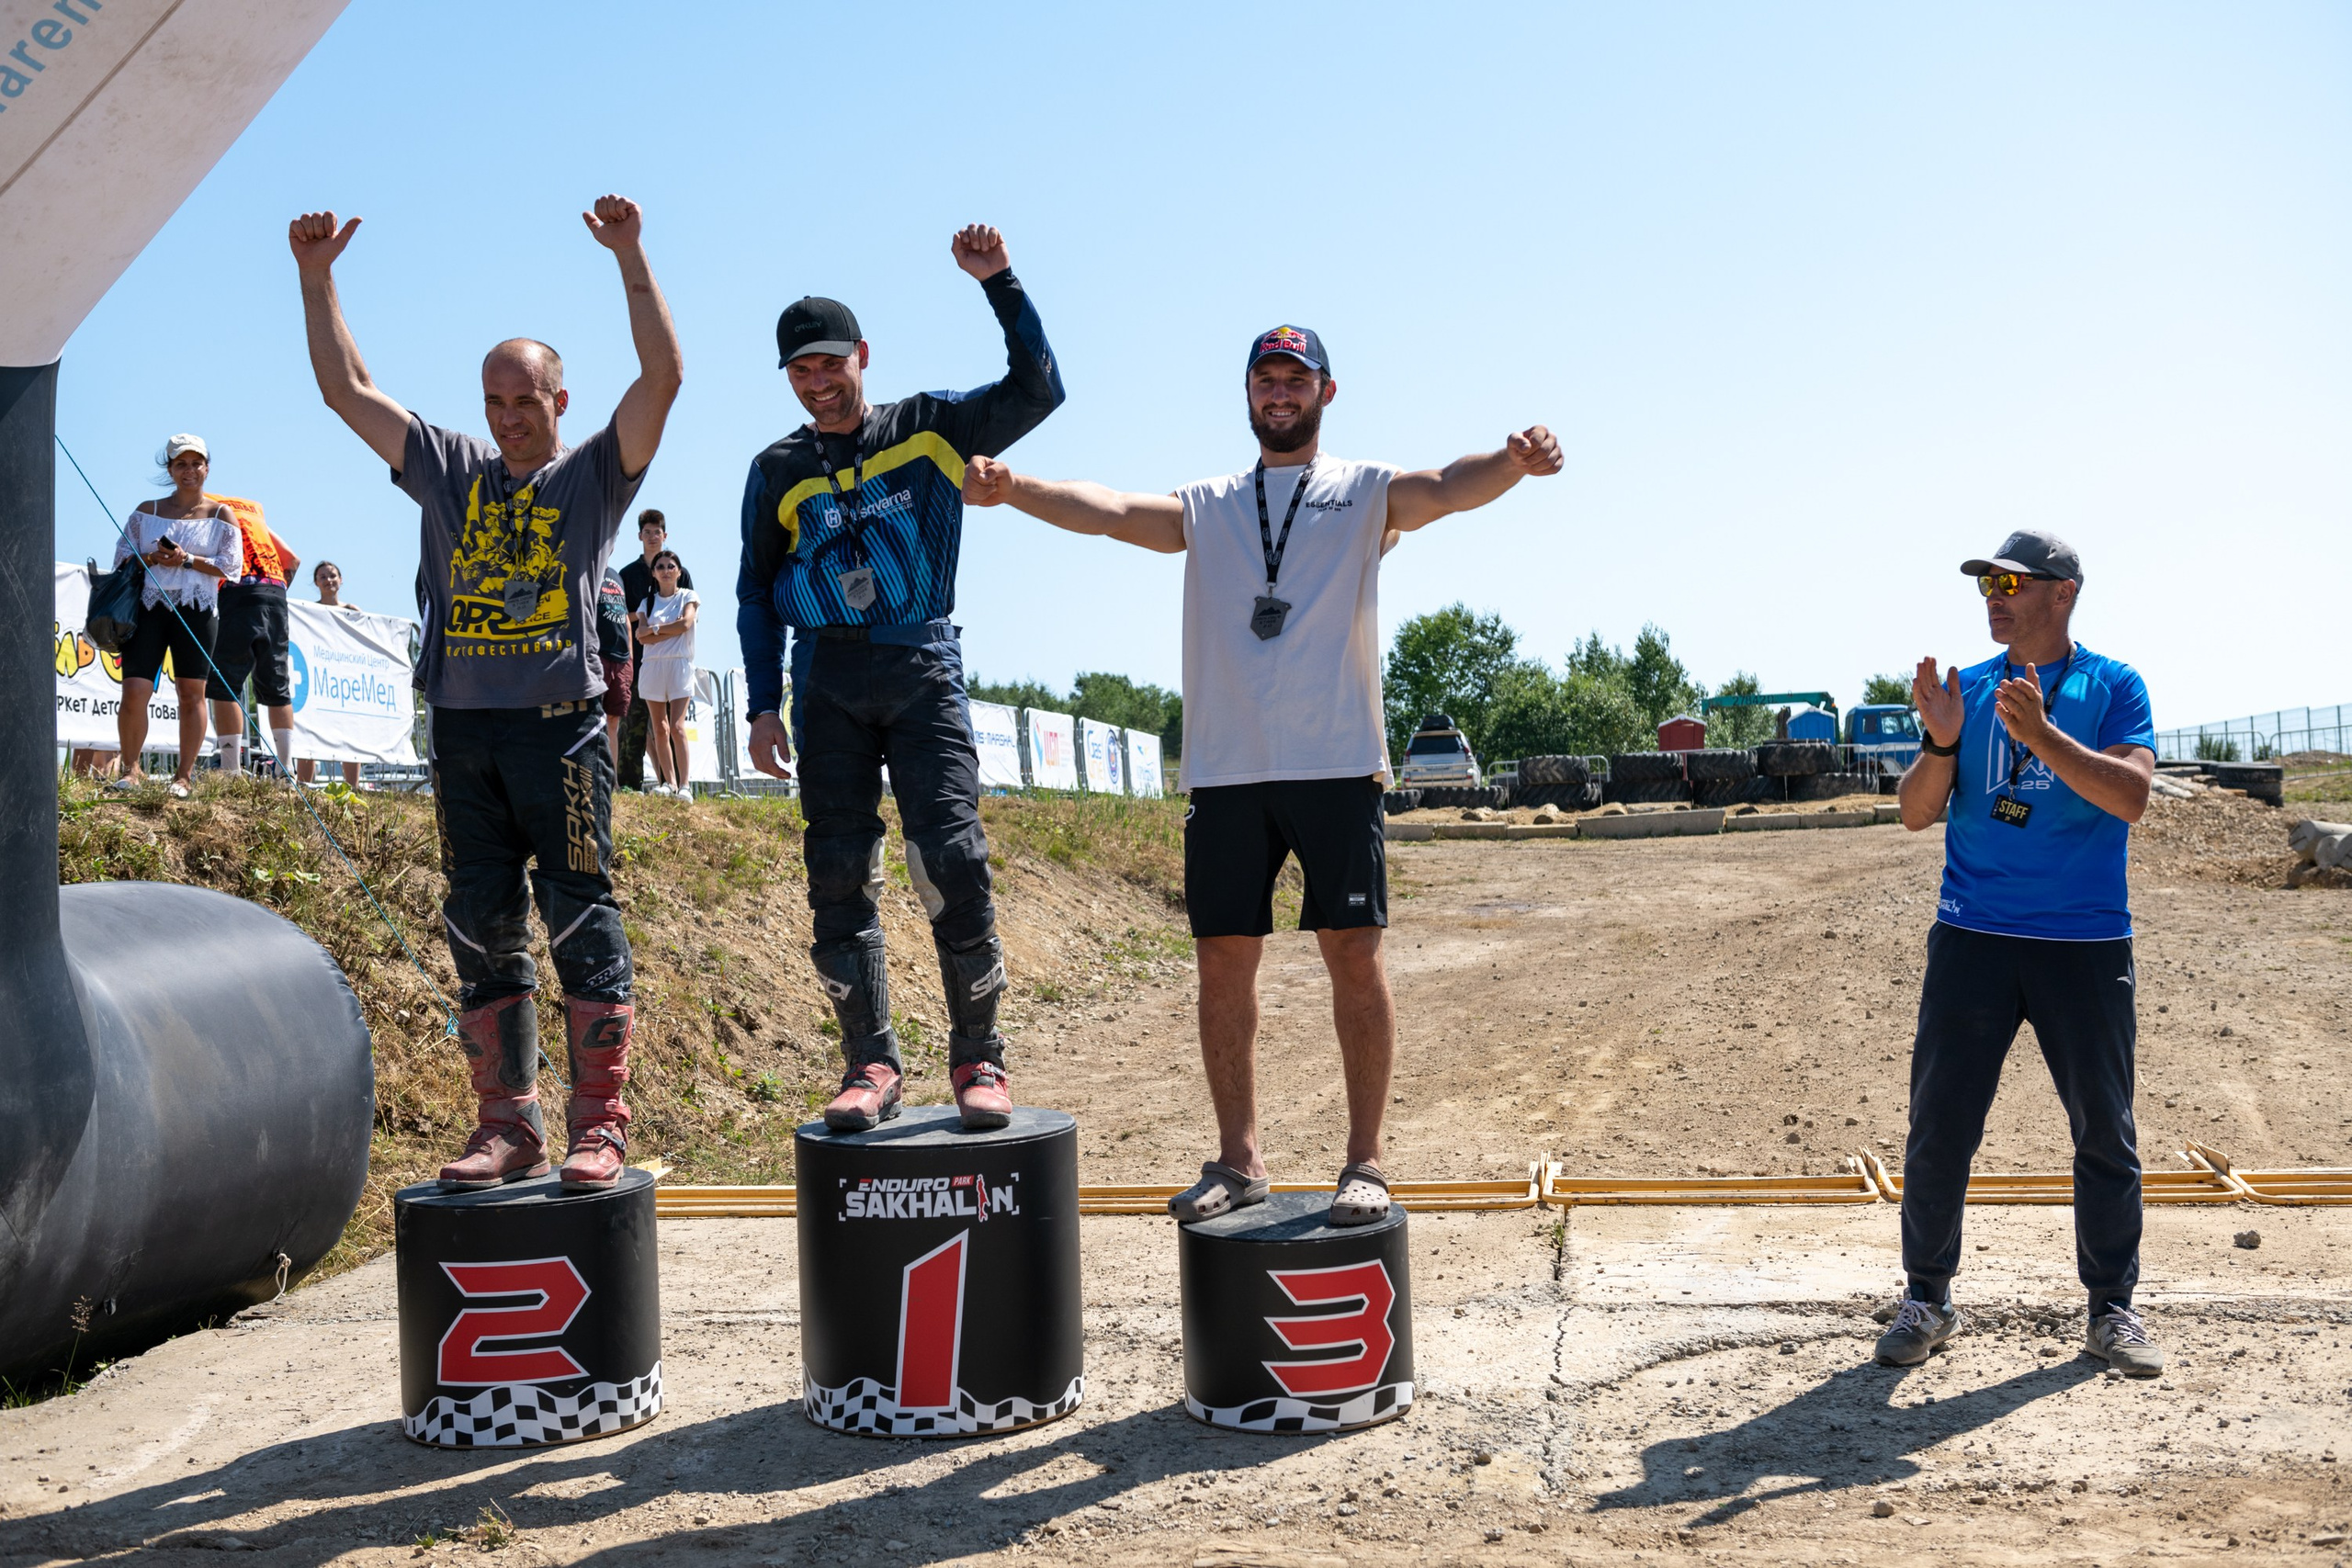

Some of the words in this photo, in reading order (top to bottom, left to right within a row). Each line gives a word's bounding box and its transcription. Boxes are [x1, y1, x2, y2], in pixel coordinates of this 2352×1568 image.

[1259, 338, 1282, 355] Red
[1283, 338, 1307, 355] Bull
[1306, 499, 1353, 509] ESSENTIALS
[313, 644, 367, 665] Медицинский
[368, 655, 390, 670] Центр
[313, 666, 396, 713] МареМед
[560, 756, 583, 872] SAKH
[1998, 800, 2029, 819] STAFF
[845, 1175, 1014, 1222] SAKHALIN
[857, 1177, 951, 1192] ENDURO
[953, 1176, 973, 1186] PARK
[437, 1256, 593, 1387] 2
[895, 1229, 969, 1408] 1
[1261, 1258, 1396, 1397] 3
